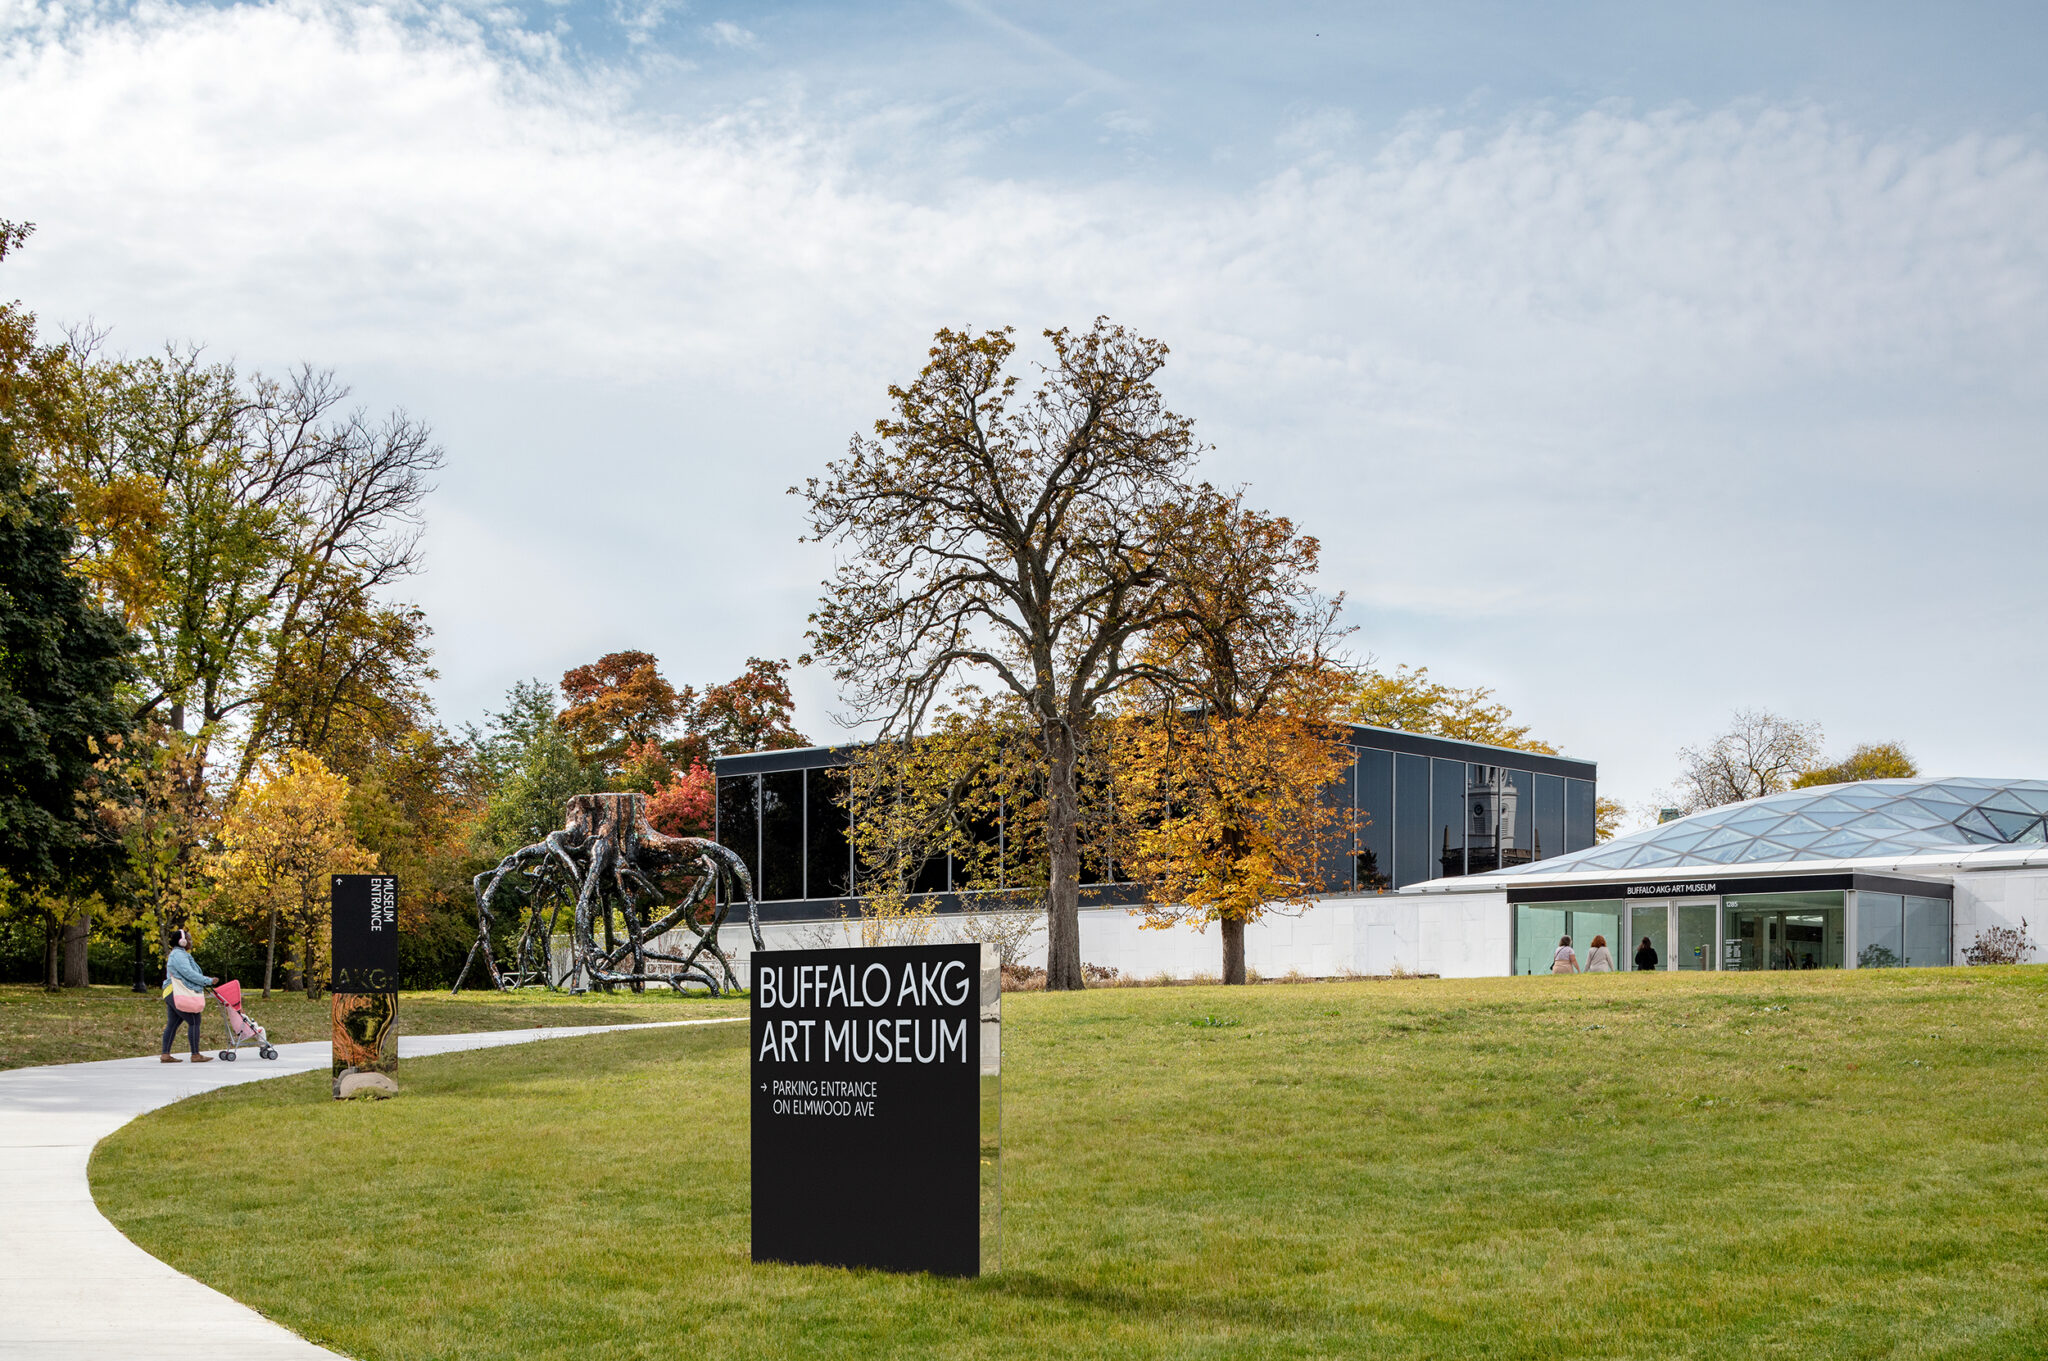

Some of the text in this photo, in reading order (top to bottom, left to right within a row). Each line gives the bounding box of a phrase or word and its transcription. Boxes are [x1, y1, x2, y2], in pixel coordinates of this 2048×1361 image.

[371, 878, 382, 931] ENTRANCE
[383, 878, 394, 922] MUSEUM
[1627, 883, 1716, 895] BUFFALO AKG ART MUSEUM
[760, 960, 970, 1008] BUFFALO AKG
[759, 1019, 967, 1063] ART MUSEUM
[773, 1080, 877, 1098] PARKING ENTRANCE
[773, 1099, 875, 1117] ON ELMWOOD AVE
